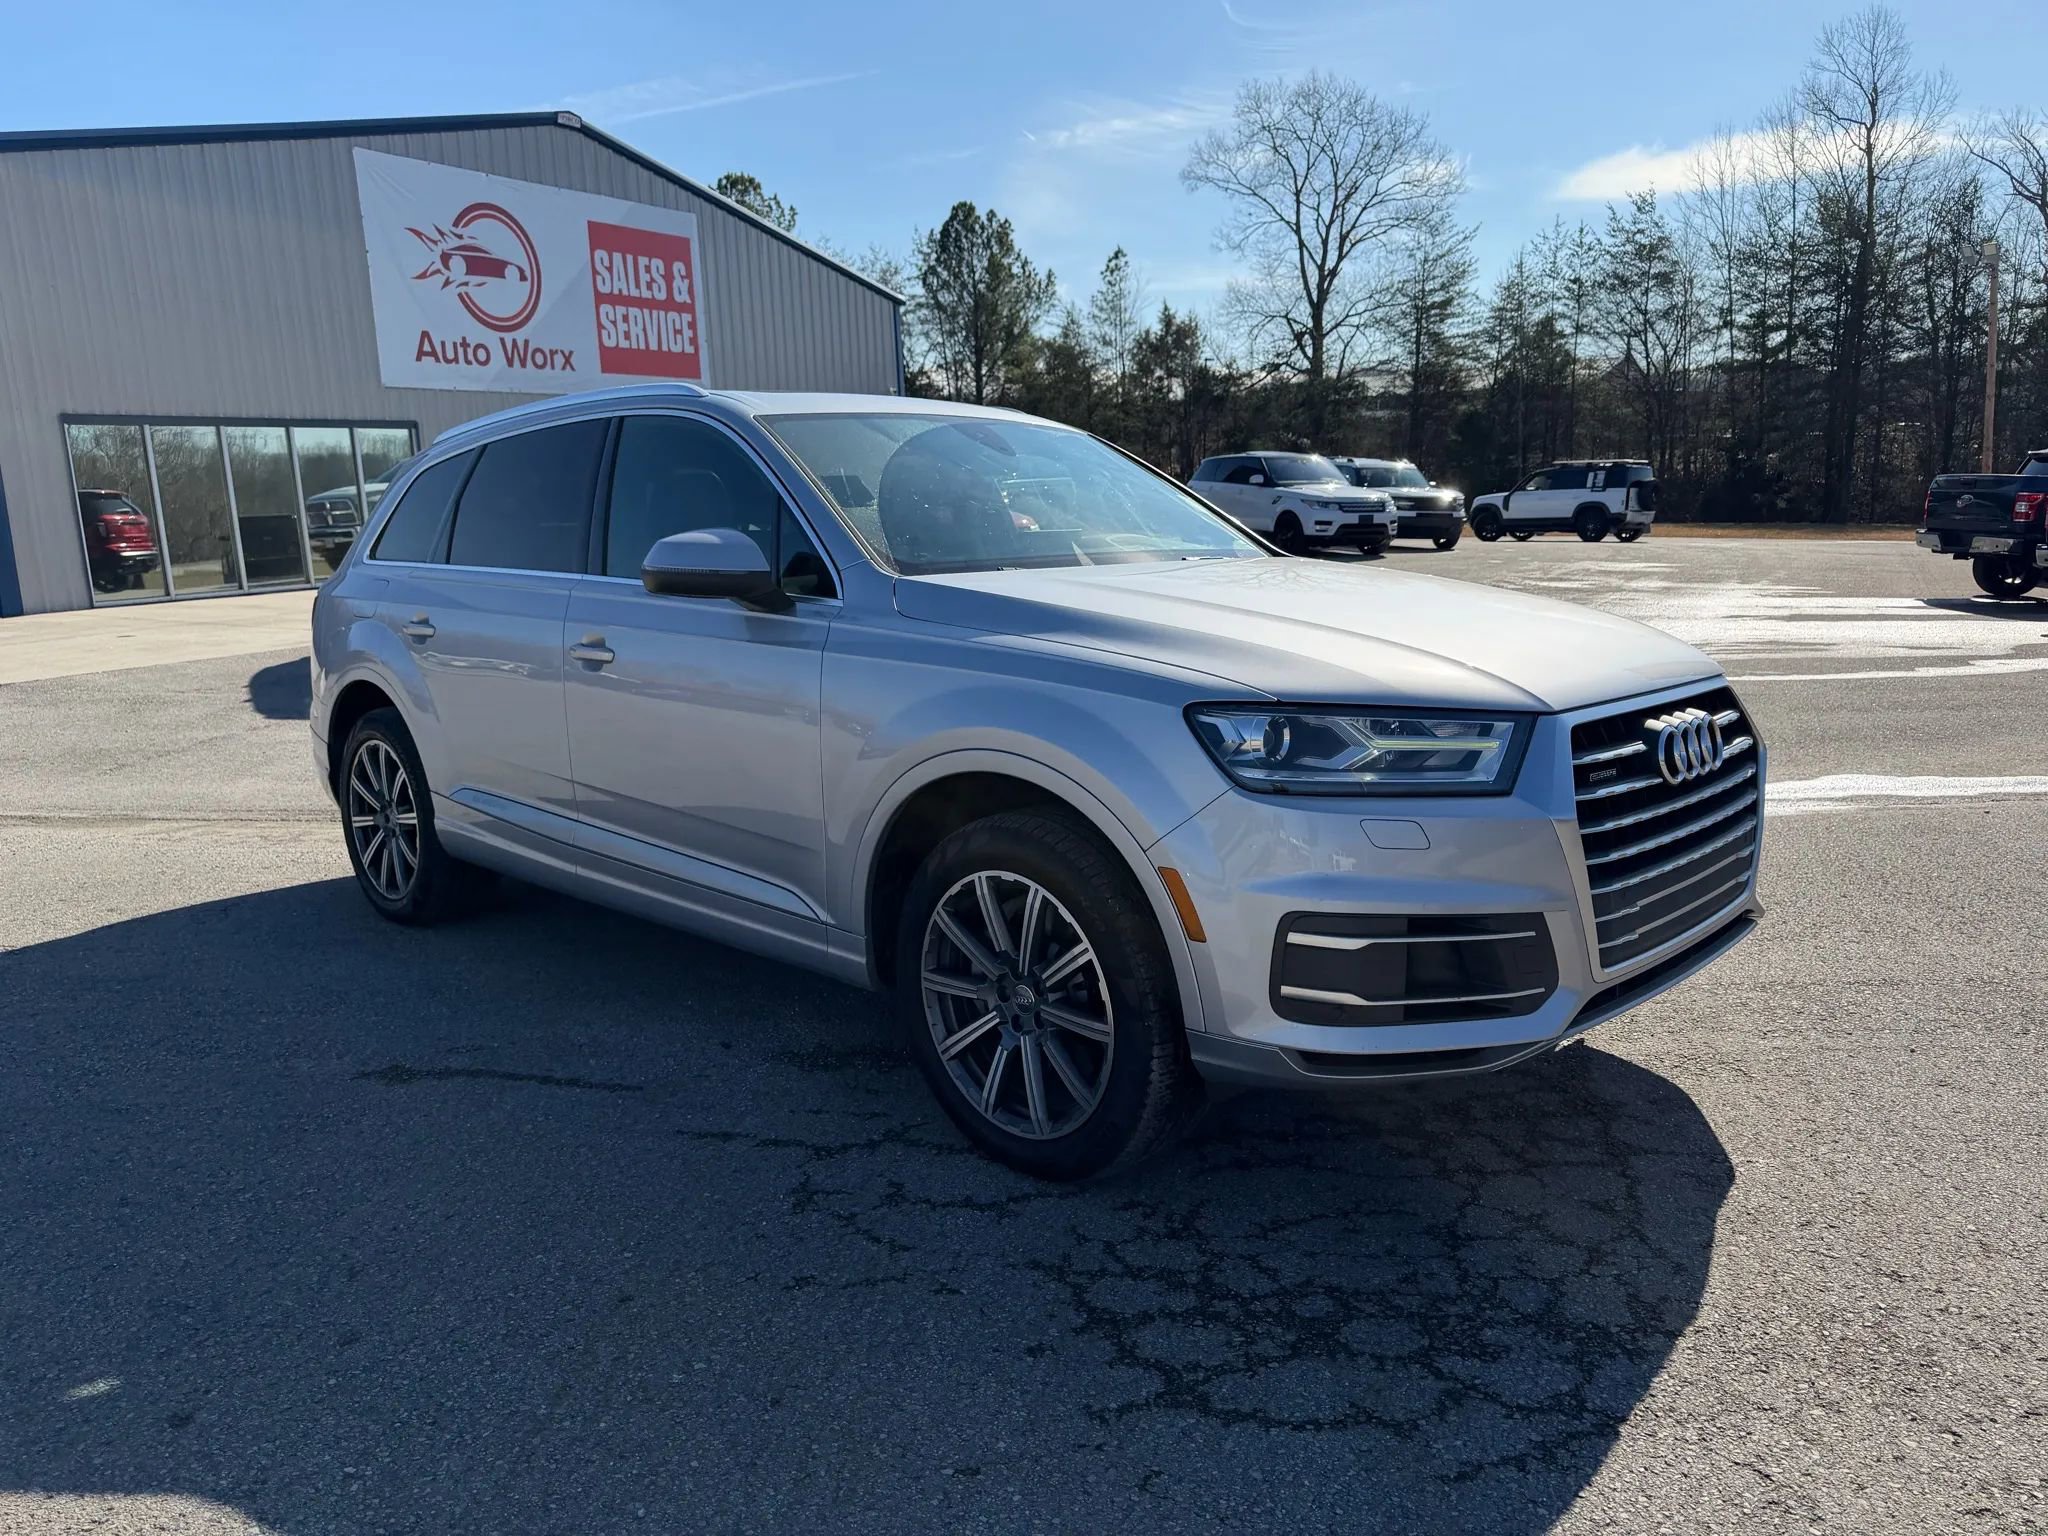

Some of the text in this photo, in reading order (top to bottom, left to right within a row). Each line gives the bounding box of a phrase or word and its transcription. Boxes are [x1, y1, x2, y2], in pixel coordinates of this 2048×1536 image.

[594, 249, 691, 303] SALES &
[415, 330, 576, 372] Auto Worx
[600, 304, 695, 354] SERVICE
